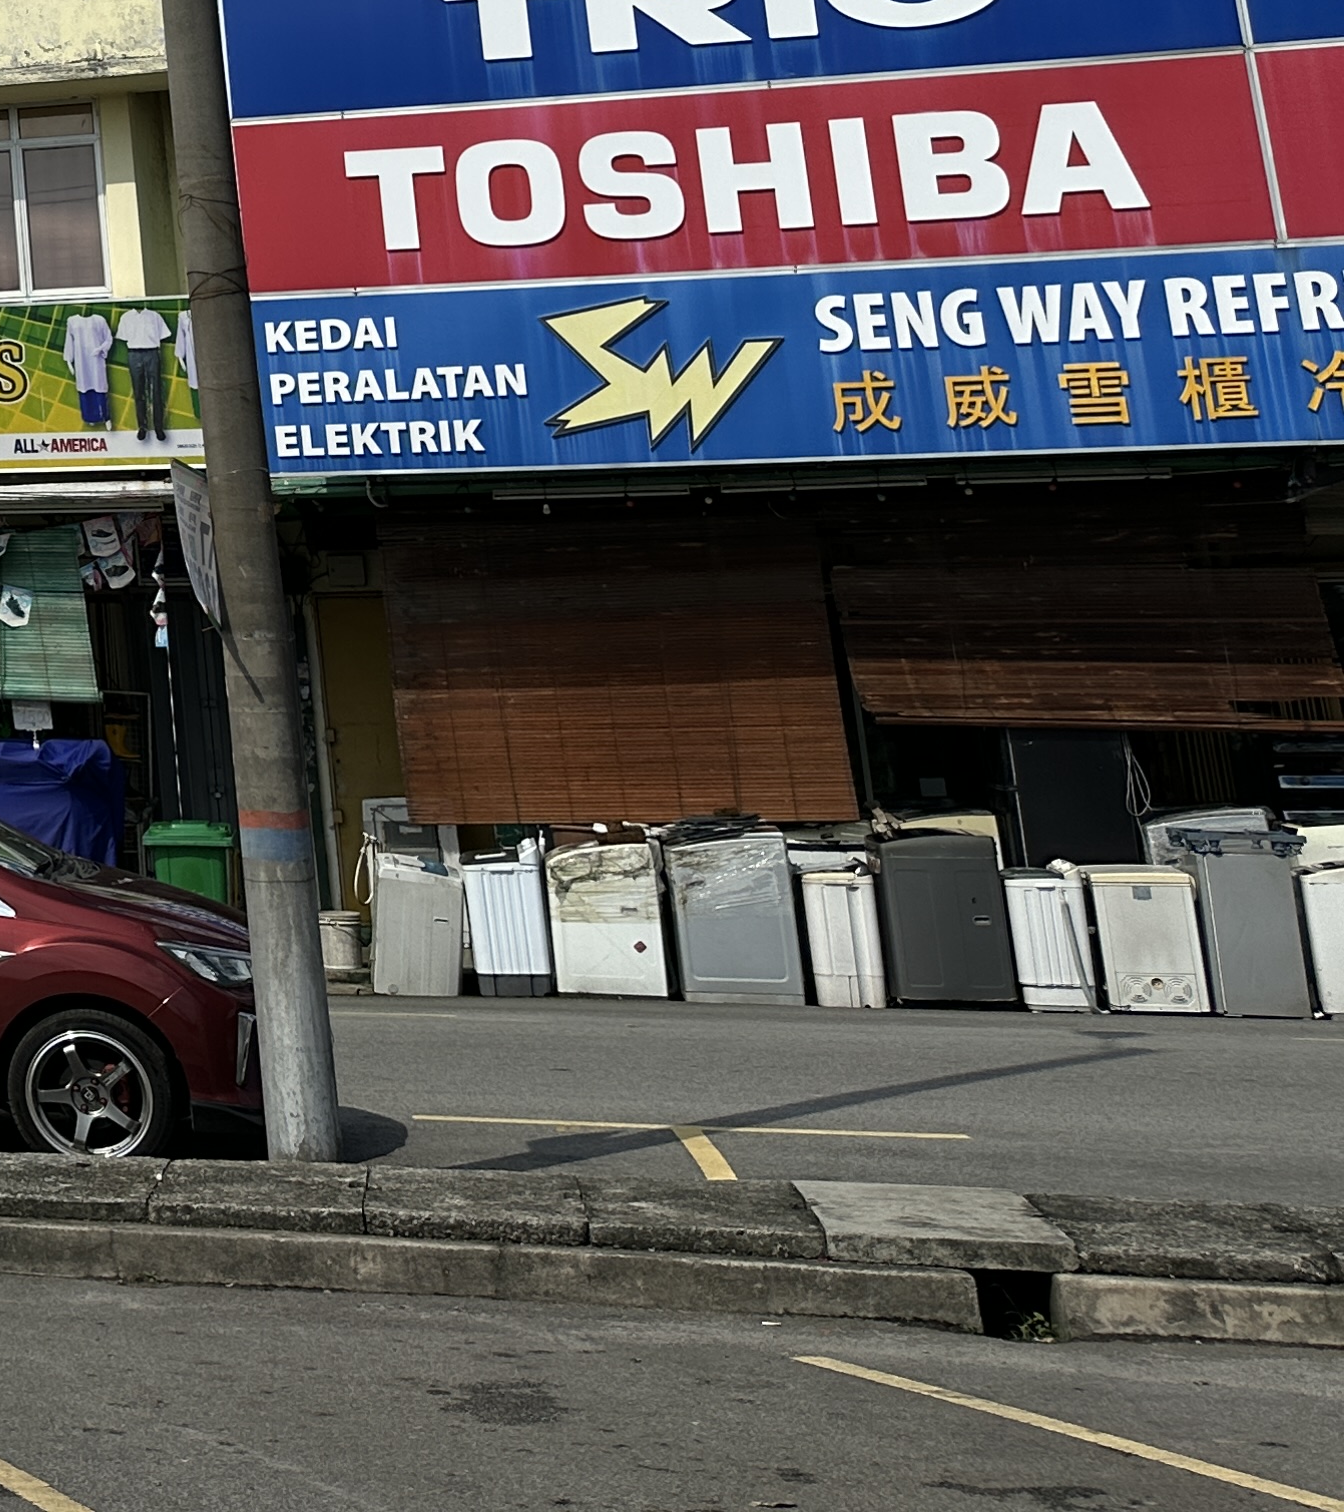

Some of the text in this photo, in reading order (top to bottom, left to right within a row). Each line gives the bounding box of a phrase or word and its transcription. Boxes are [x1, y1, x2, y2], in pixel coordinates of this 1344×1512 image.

[343, 100, 1152, 252] TOSHIBA
[263, 317, 398, 355] KEDAI
[814, 287, 987, 354] SENG
[996, 278, 1147, 345] WAY
[268, 362, 528, 408] PERALATAN
[13, 438, 109, 455] ALL AMERICA
[274, 418, 486, 459] ELEKTRIK
